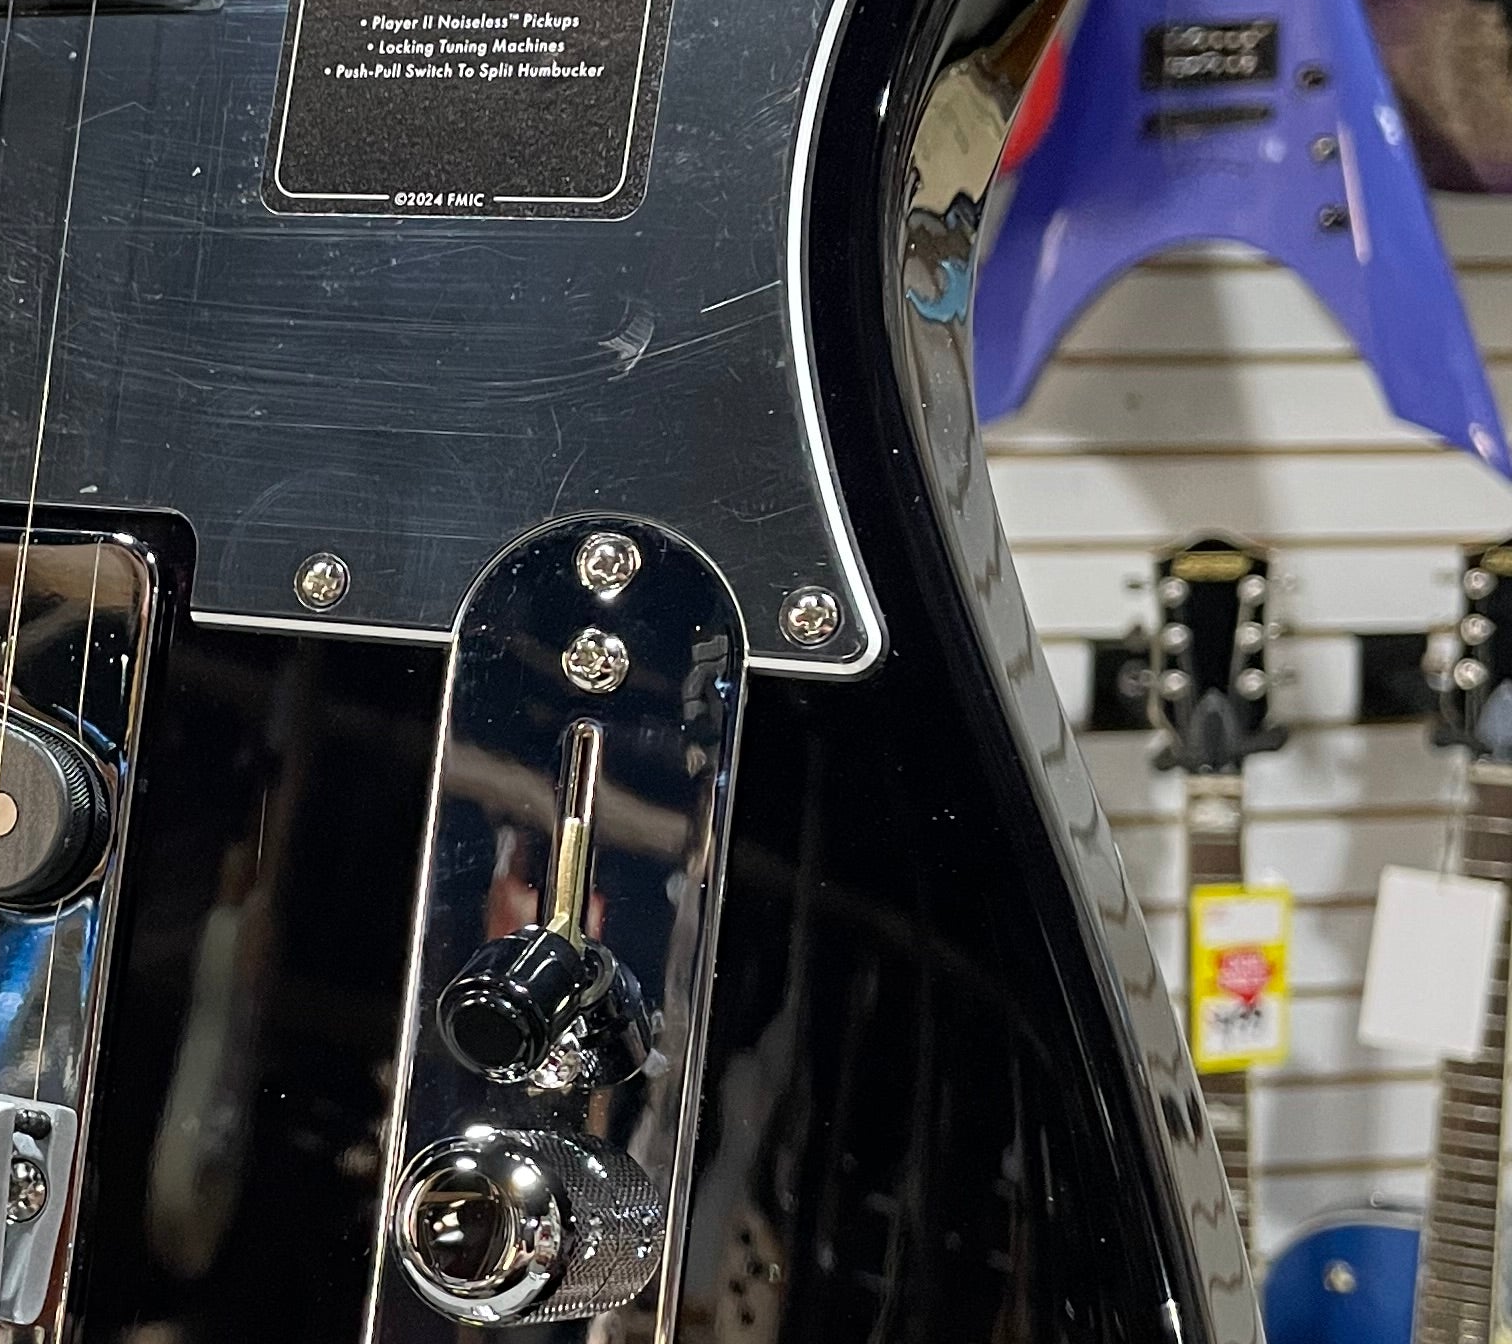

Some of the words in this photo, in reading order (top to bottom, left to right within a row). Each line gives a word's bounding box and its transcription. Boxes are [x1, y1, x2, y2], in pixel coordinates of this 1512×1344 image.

[371, 14, 419, 34] Player
[422, 14, 434, 30] II
[522, 11, 580, 32] Pickups
[378, 38, 434, 58] Locking
[438, 39, 488, 57] Tuning
[491, 37, 566, 53] Machines
[335, 62, 402, 79] Push-Pull
[404, 62, 453, 79] Switch
[457, 62, 475, 78] To
[478, 61, 514, 82] Split
[517, 60, 605, 78] Humbucker
[447, 192, 485, 207] FMIC
